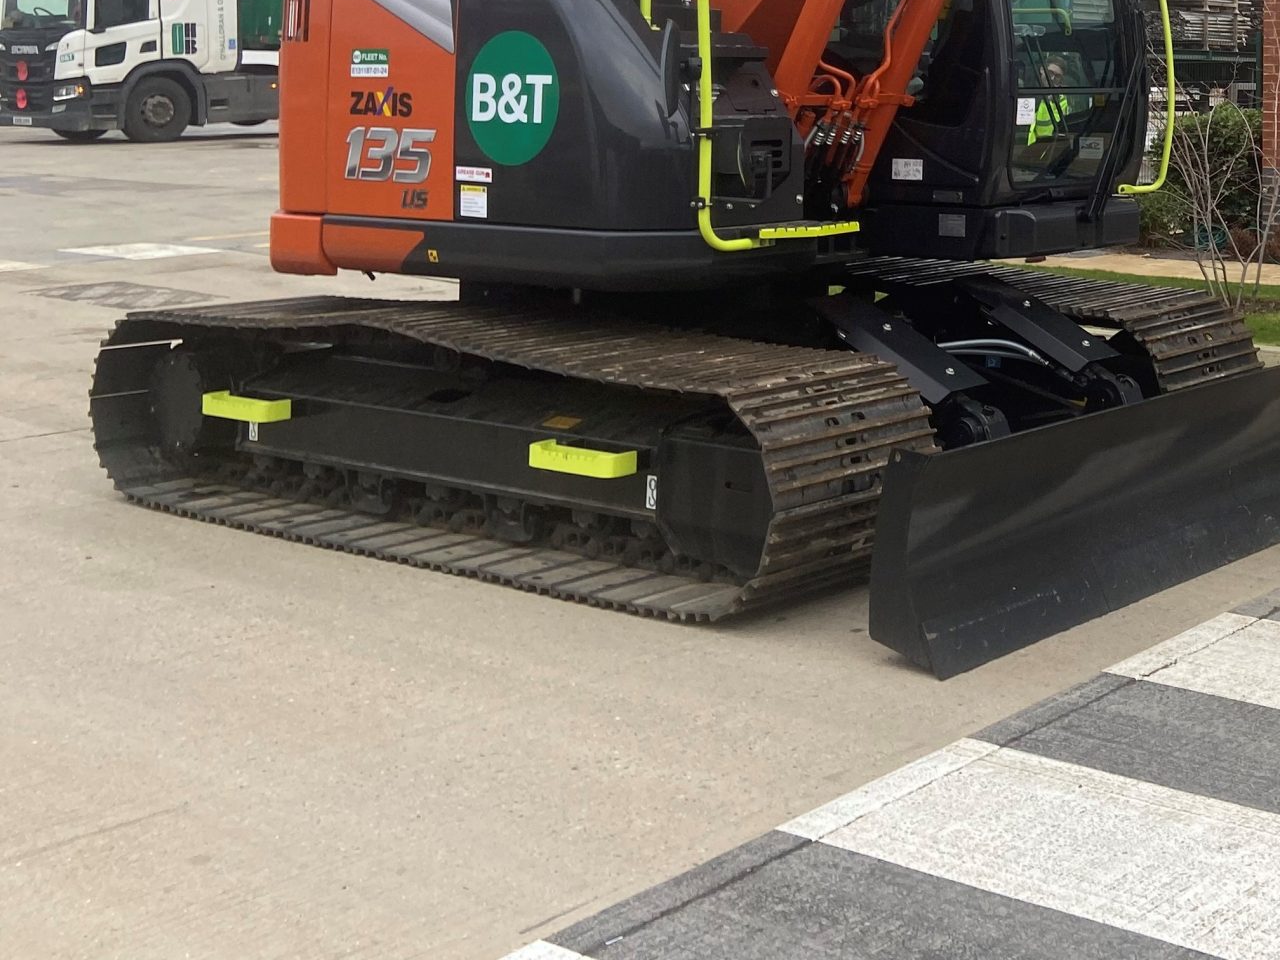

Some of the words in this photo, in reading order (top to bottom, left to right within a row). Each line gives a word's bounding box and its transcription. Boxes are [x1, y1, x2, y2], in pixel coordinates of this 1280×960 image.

[350, 86, 412, 117] ZAXIS
[472, 73, 552, 124] B&T
[344, 126, 437, 183] 135
